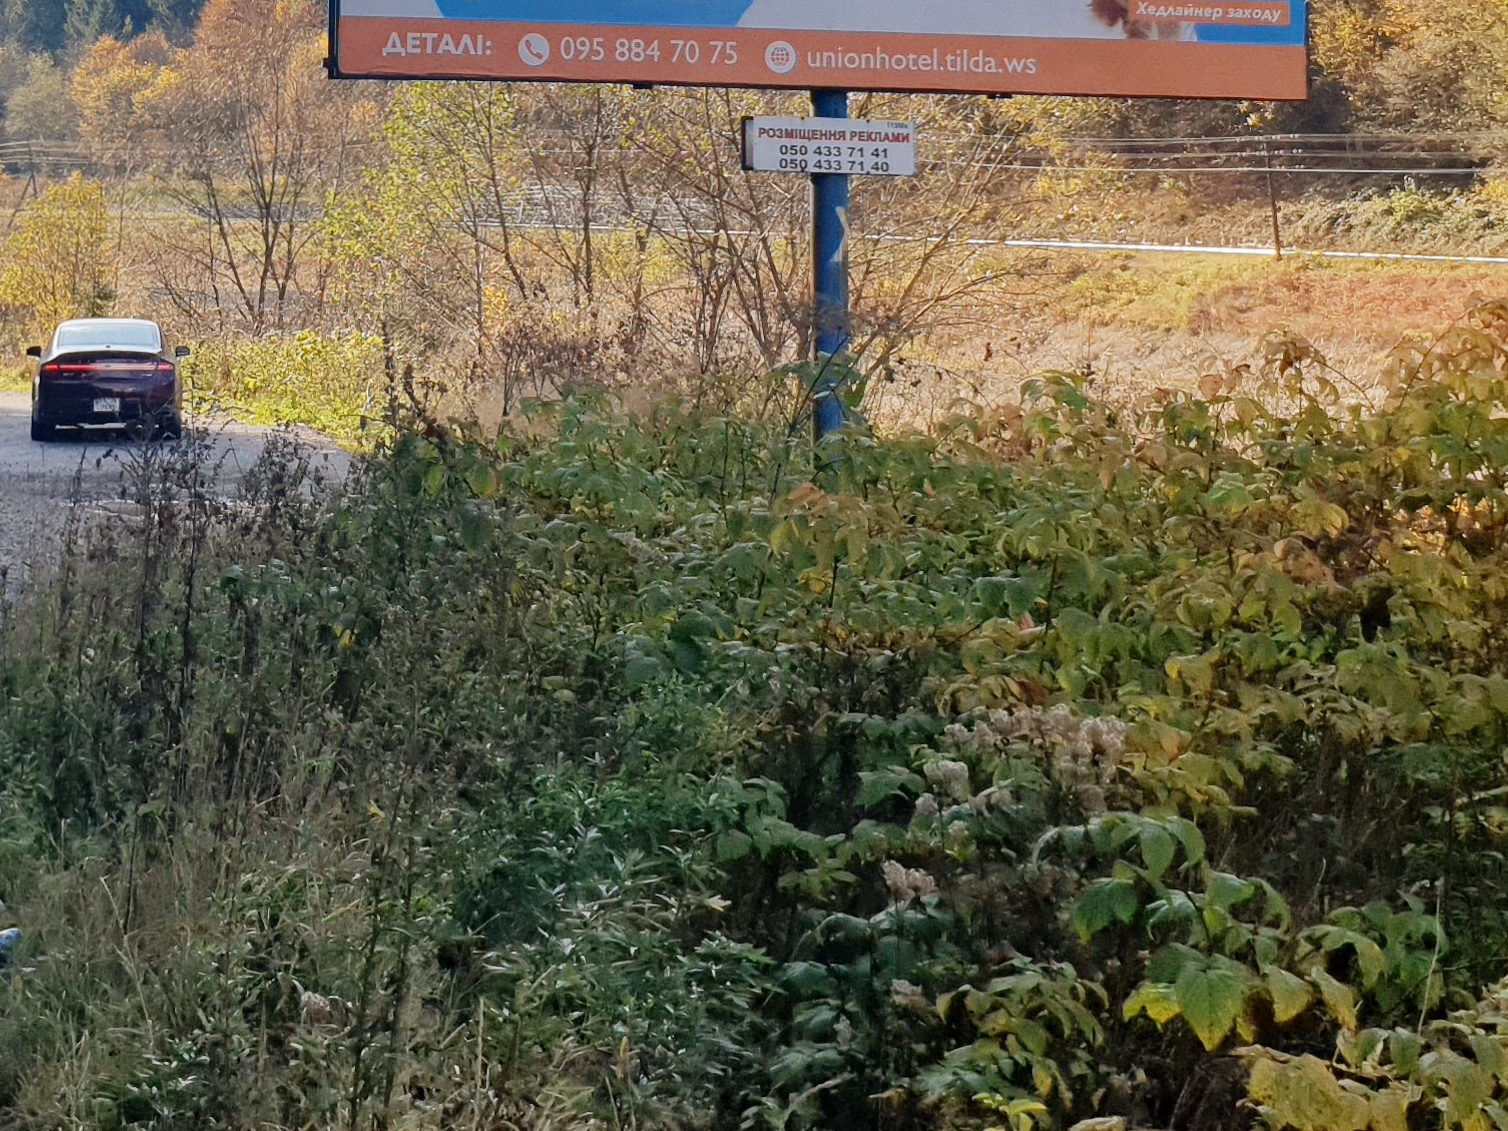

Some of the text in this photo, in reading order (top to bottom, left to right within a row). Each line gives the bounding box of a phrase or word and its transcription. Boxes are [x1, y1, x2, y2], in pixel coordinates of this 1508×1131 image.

[1135, 1, 1282, 23] Хедлайнер заходу
[381, 31, 1037, 76] ДЕТАЛІ: 095 884 70 75 unionhotel.tilda.ws
[757, 126, 910, 144] РОЗМІЩЕННЯ РЕКЛАМИ
[778, 144, 889, 159] 050 433 71 41
[778, 157, 890, 173] 050 433 71 40
